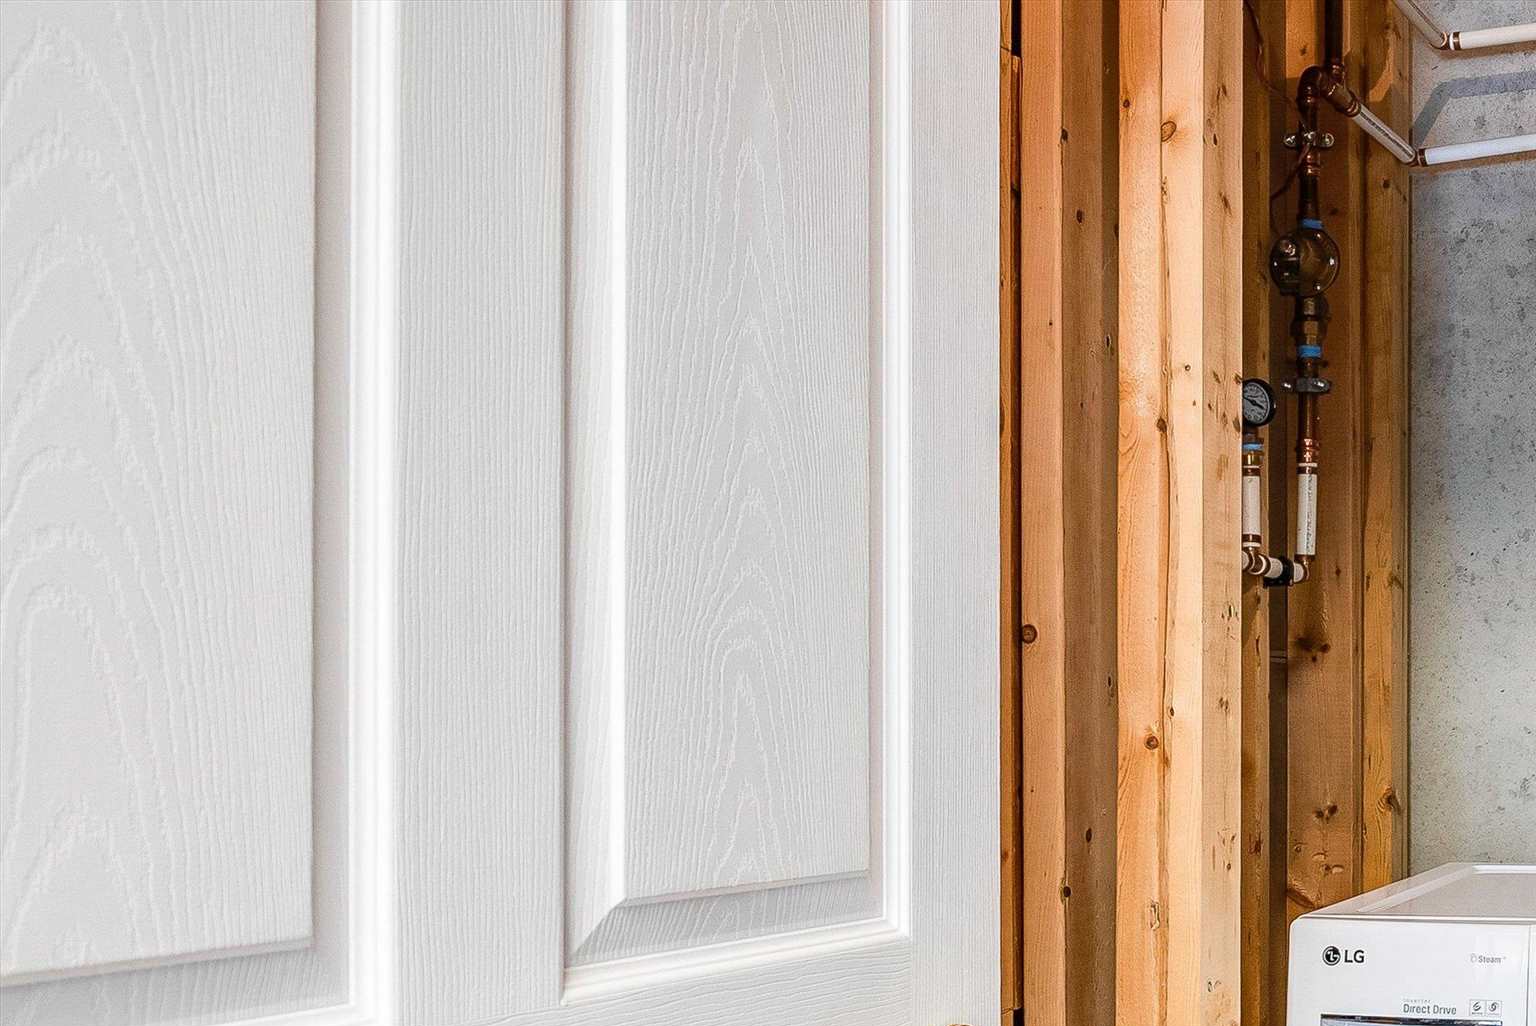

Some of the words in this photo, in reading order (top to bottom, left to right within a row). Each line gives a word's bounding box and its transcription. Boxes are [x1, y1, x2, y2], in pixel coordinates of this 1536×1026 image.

[1344, 949, 1365, 964] LG
[1477, 954, 1502, 964] Steam
[1403, 1003, 1430, 1014] Direct
[1432, 1004, 1457, 1015] Drive
